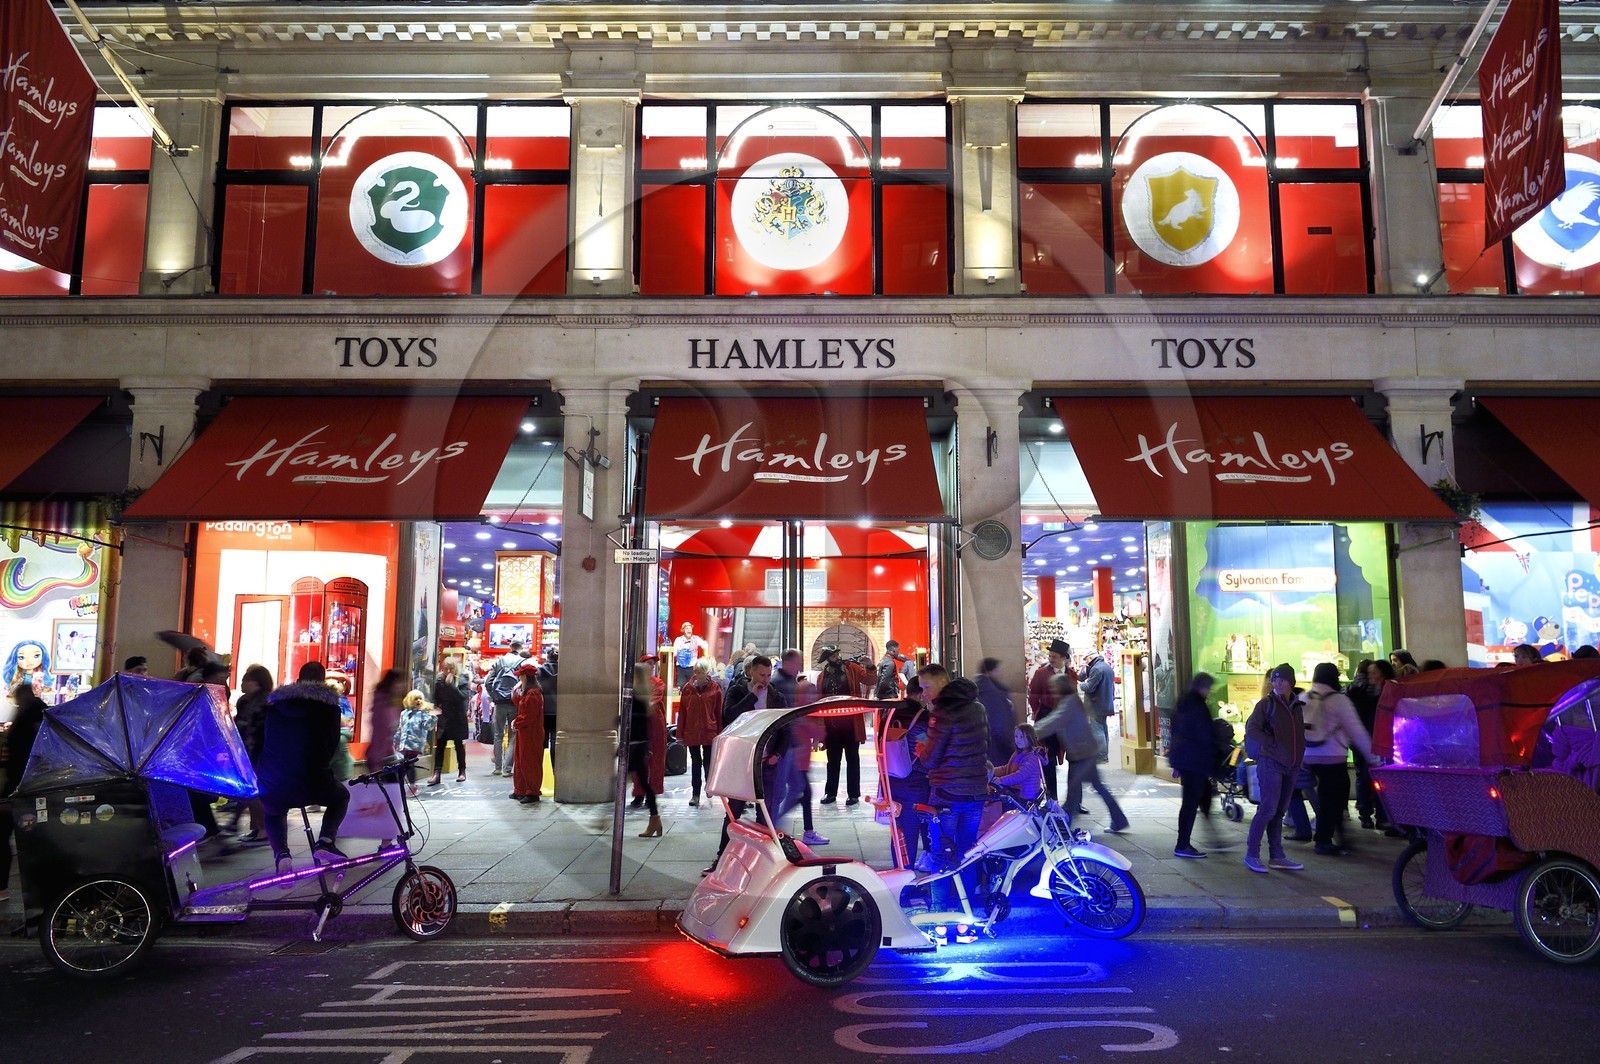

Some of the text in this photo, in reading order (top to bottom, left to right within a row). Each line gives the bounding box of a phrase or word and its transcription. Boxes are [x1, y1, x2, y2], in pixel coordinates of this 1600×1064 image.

[0, 52, 77, 130] Hamleys
[1488, 28, 1548, 108] Hamleys
[1490, 93, 1548, 169] Hamleys
[0, 183, 60, 256] amleys
[1493, 159, 1550, 229] Hamleys
[335, 336, 438, 368] TOYS
[687, 338, 897, 370] HAMLEYS
[1151, 338, 1256, 369] TOYS
[225, 425, 469, 486] Hamleys
[674, 421, 907, 486] Hamleys
[1124, 421, 1354, 486] Hamleys
[1225, 573, 1279, 589] Sylvanian
[833, 962, 1180, 1056] BUS
